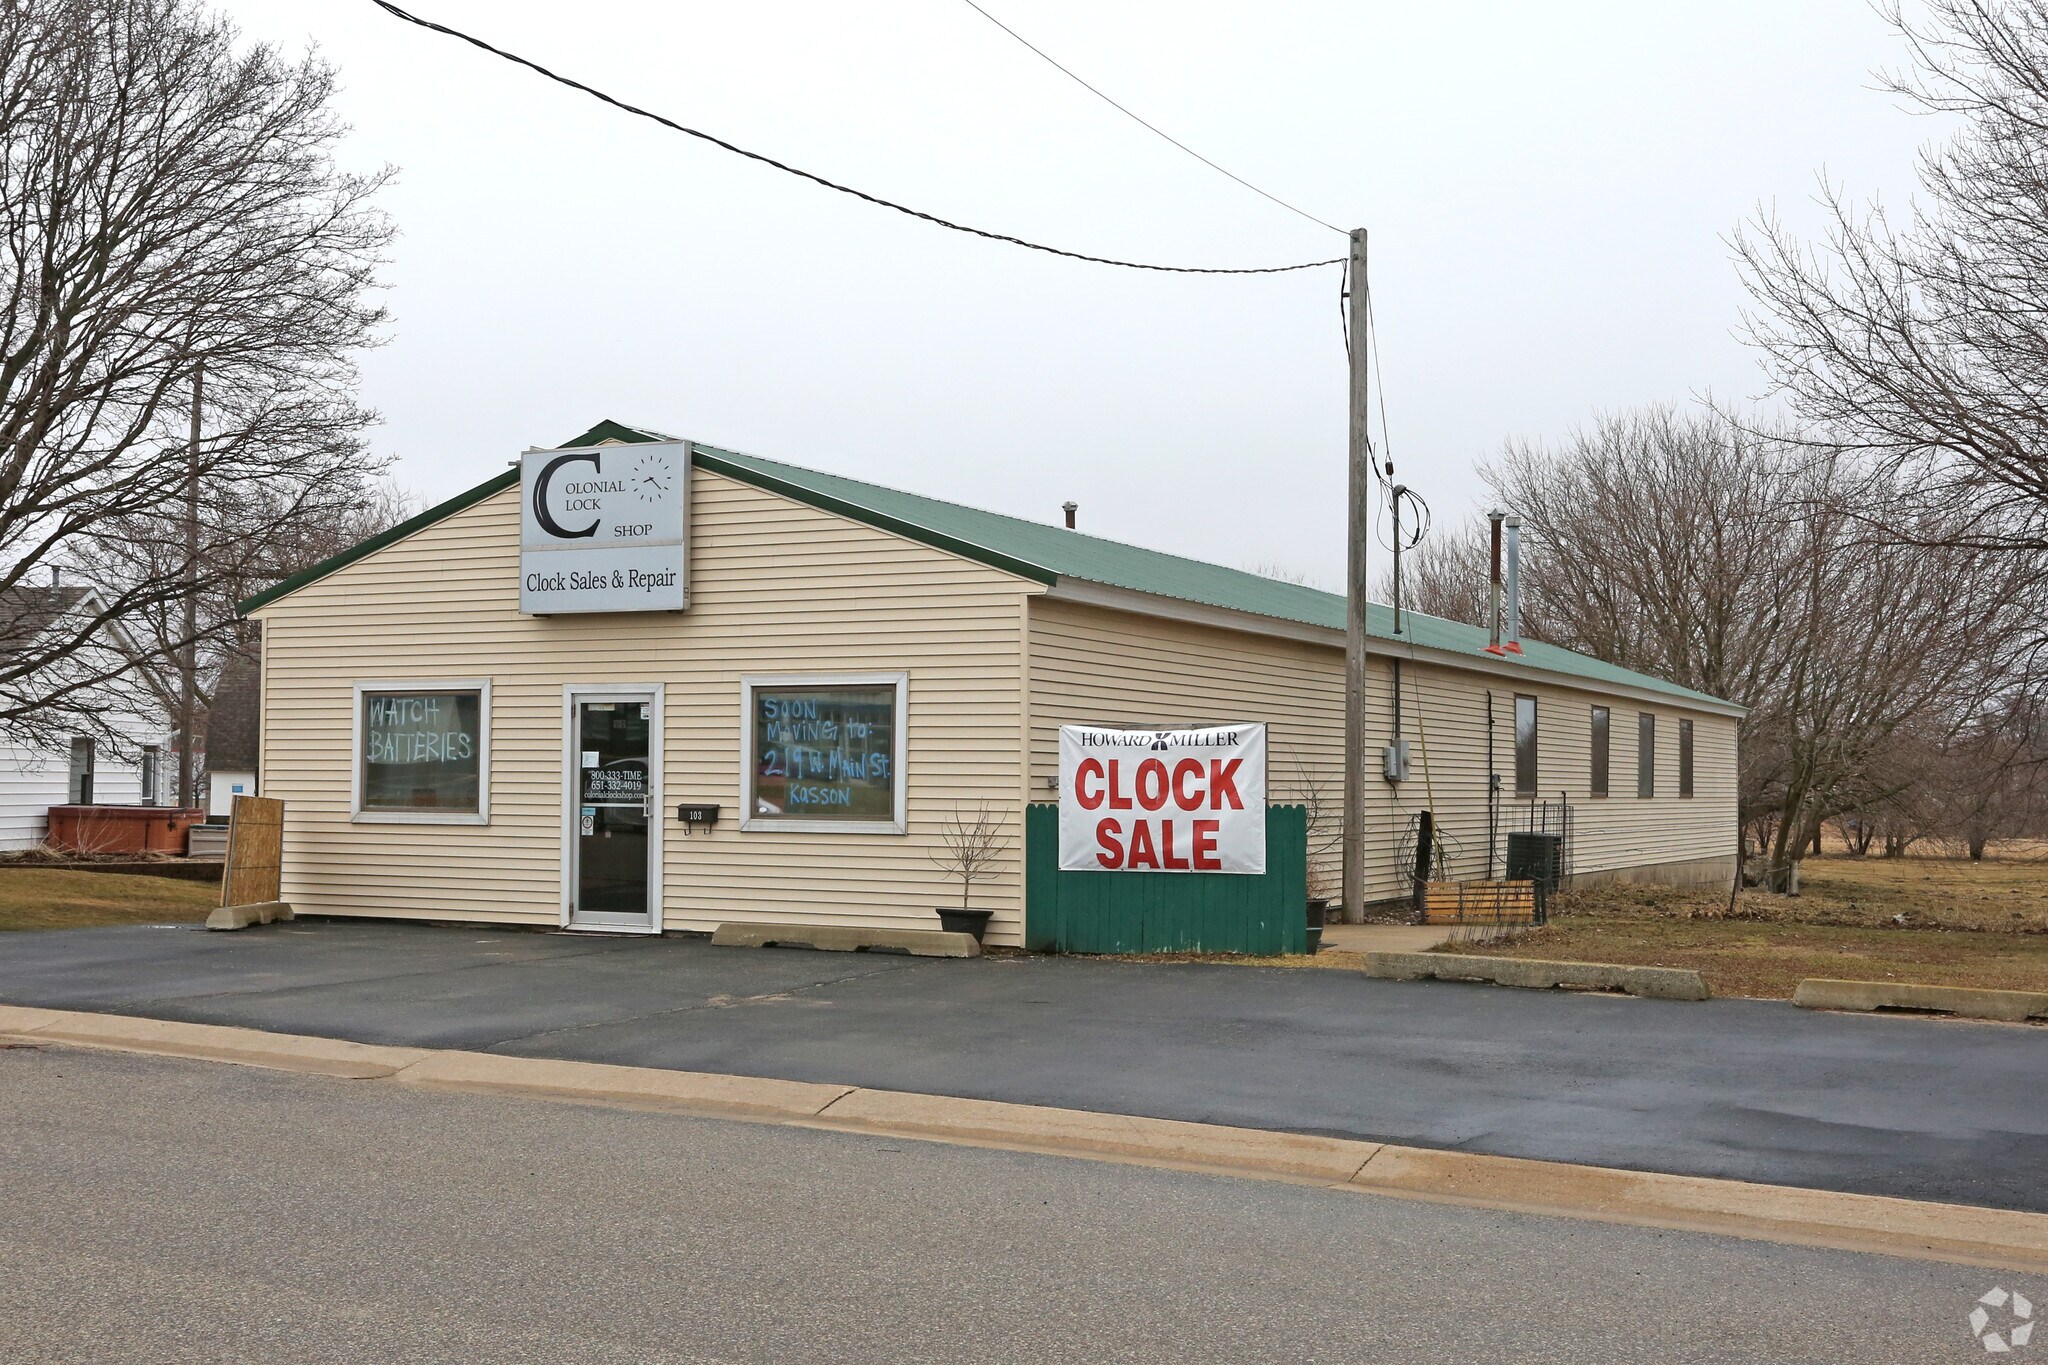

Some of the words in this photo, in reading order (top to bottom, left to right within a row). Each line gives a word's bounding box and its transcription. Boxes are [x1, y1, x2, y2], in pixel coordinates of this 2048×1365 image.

[614, 524, 653, 537] SHOP
[526, 571, 566, 592] Clock
[570, 570, 607, 591] Sales
[611, 569, 624, 589] &
[628, 567, 676, 592] Repair
[370, 697, 440, 727] WATCH
[765, 698, 817, 719] SOON
[367, 730, 471, 763] BATTERIES
[1081, 732, 1152, 747] HOWARD
[1169, 731, 1239, 747] MILLER
[764, 746, 803, 779] 219
[590, 770, 643, 781] 800-333-TIME
[591, 780, 642, 790] 651-332-4019
[1075, 757, 1244, 811] CLOCK
[689, 811, 702, 820] 103
[1096, 817, 1222, 870] SALE
